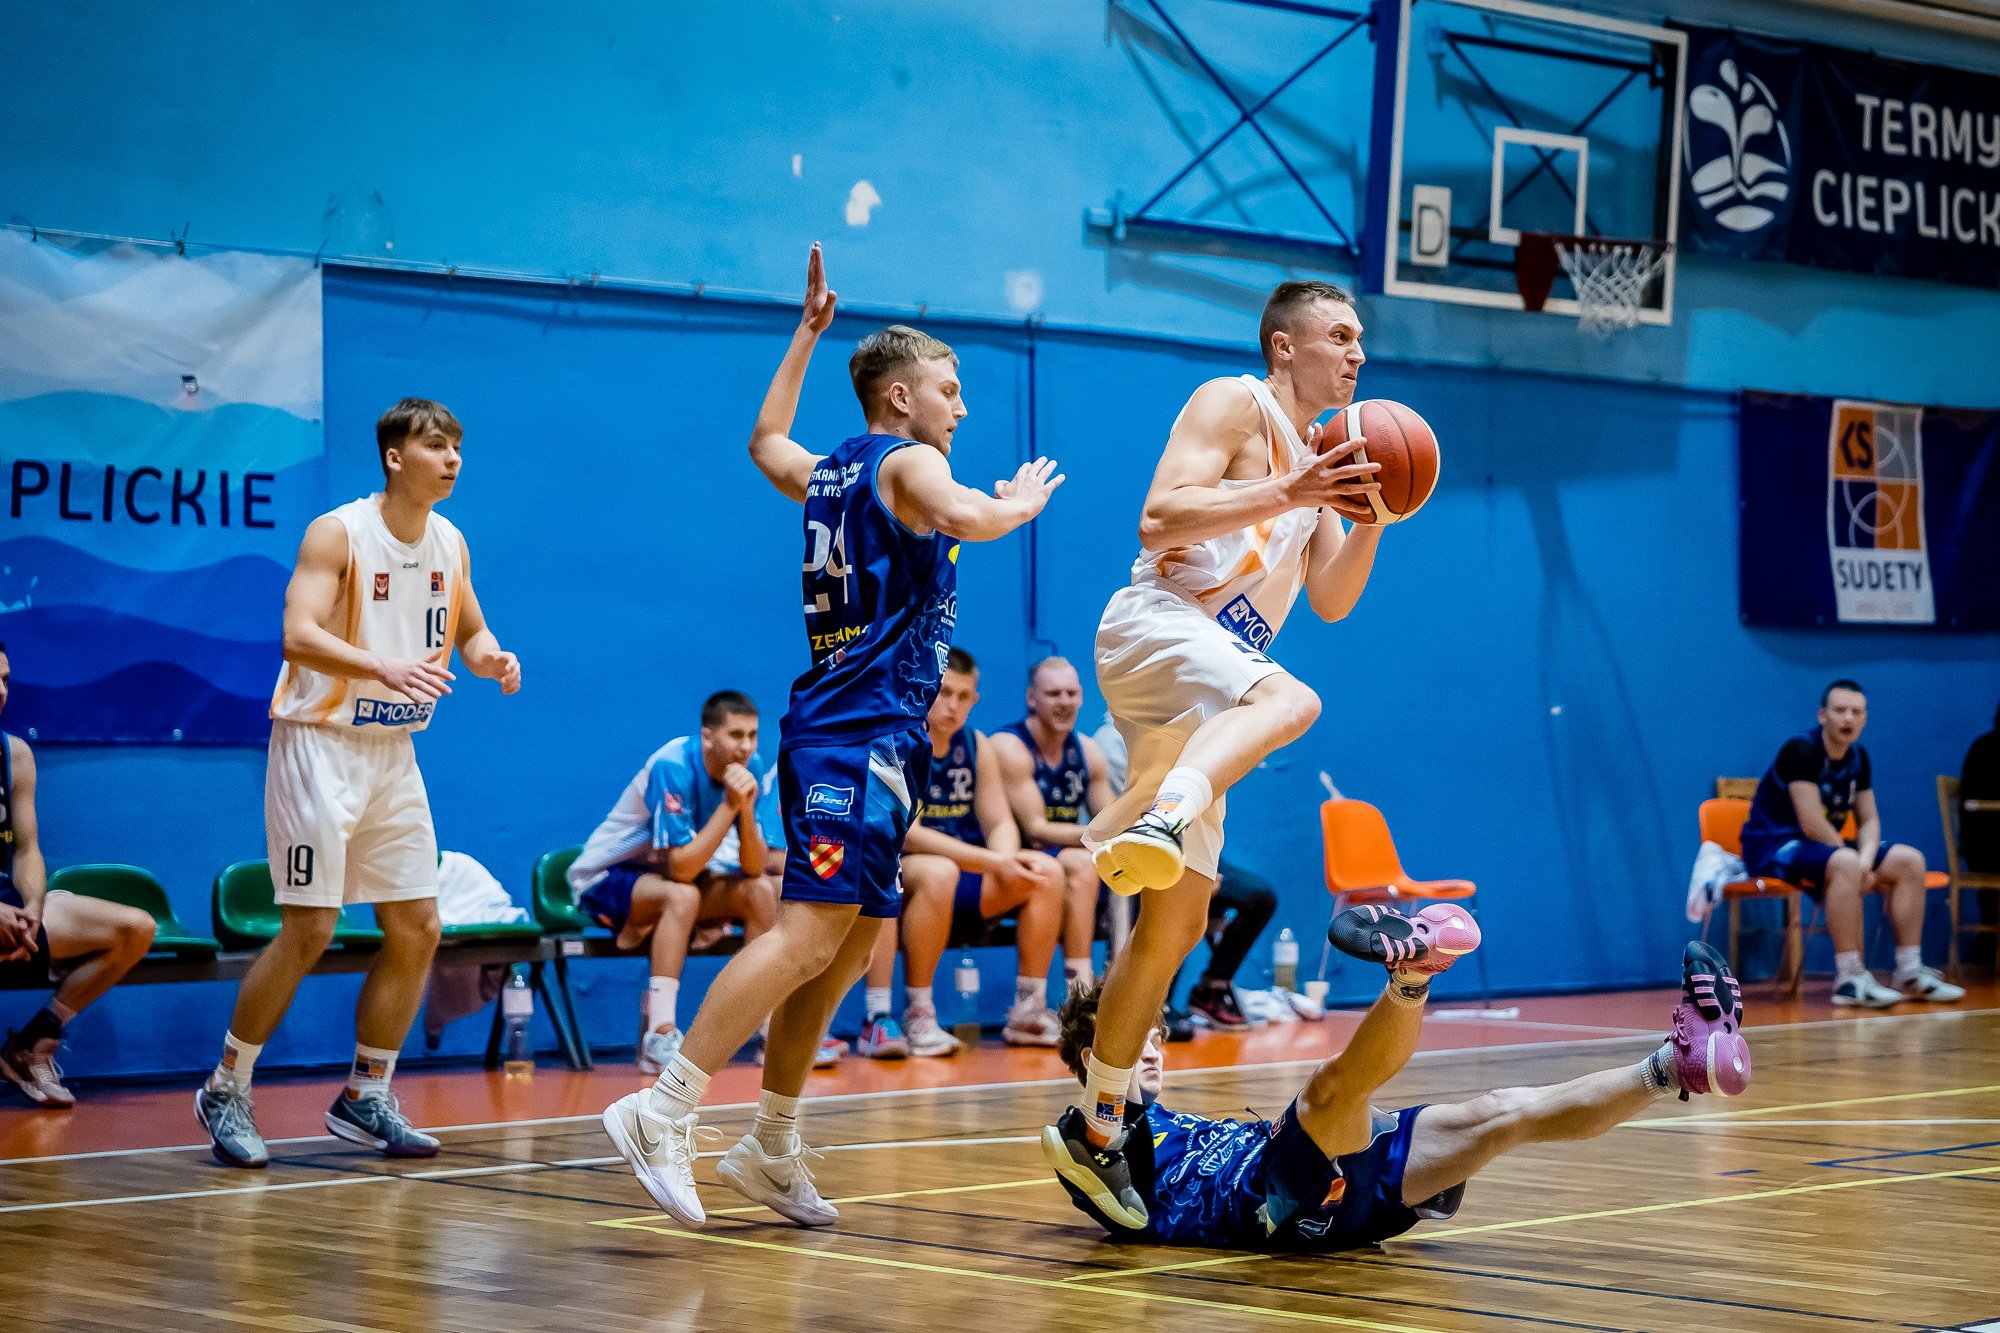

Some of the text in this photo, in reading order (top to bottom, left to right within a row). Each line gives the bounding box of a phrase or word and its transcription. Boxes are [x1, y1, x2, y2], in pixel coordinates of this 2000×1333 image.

[1855, 93, 2000, 168] TERMY
[1812, 168, 2000, 247] CIEPLICK
[11, 460, 275, 529] PLICKIE
[1836, 558, 1923, 592] SUDETY
[426, 607, 448, 648] 19
[287, 844, 314, 886] 19
